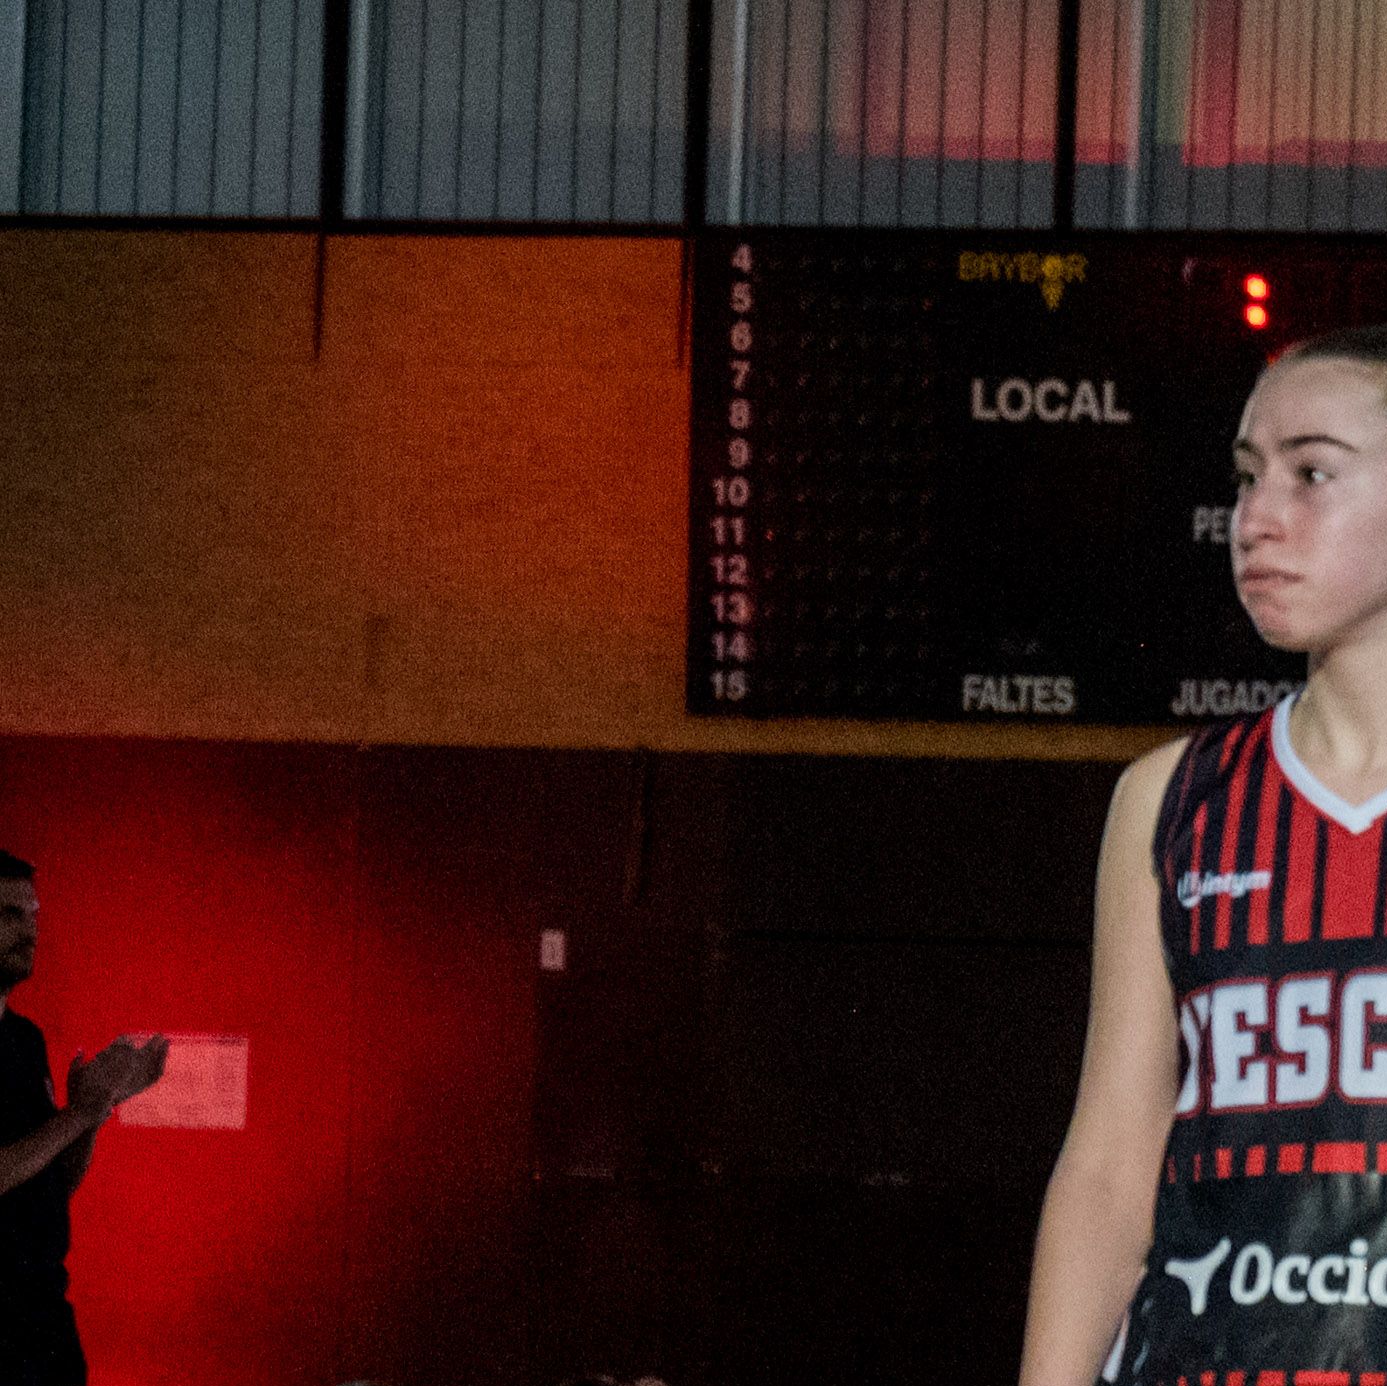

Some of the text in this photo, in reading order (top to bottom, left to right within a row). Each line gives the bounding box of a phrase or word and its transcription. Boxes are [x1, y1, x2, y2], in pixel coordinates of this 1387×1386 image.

[731, 244, 752, 272] 4
[730, 321, 751, 350] 6
[730, 361, 751, 390] 7
[729, 399, 750, 429] 8
[969, 377, 1131, 423] LOCAL
[729, 438, 749, 468] 9
[712, 476, 750, 508] 10
[711, 516, 746, 544] 11
[711, 554, 748, 585] 12
[711, 594, 750, 623] 13
[711, 631, 750, 661] 14
[711, 670, 748, 700] 15
[962, 673, 1076, 714] FALTES
